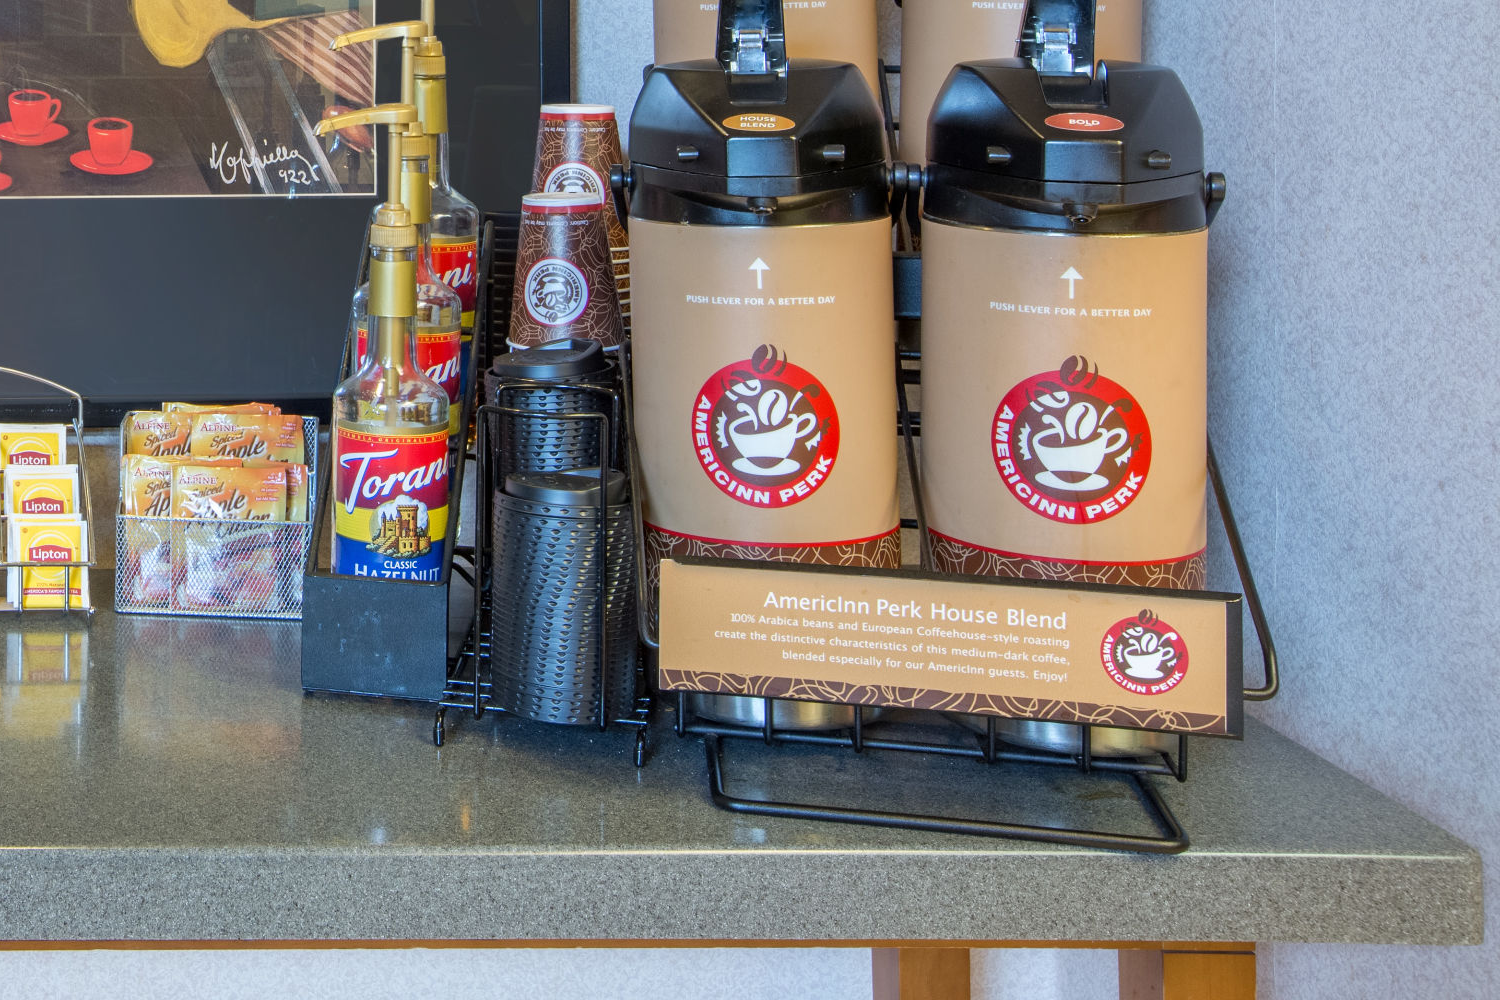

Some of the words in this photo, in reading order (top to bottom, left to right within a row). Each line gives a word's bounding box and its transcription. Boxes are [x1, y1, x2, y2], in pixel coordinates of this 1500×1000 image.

[972, 1, 994, 9] PUSH
[533, 266, 550, 283] PERK
[686, 294, 708, 303] PUSH
[712, 296, 741, 305] LEVER
[745, 297, 764, 305] FOR
[778, 297, 815, 306] BETTER
[817, 296, 836, 304] DAY
[989, 301, 1015, 312] PUSH
[1018, 304, 1050, 314] LEVER
[1054, 307, 1076, 316] FOR
[1080, 308, 1087, 317] A
[1091, 308, 1130, 317] BETTER
[1133, 308, 1152, 317] DAY
[133, 419, 170, 431] ALPINE
[200, 421, 237, 432] ALPINE
[144, 427, 177, 448] Spiced
[695, 394, 770, 504] AMERICINN
[779, 454, 833, 503] PERK
[12, 455, 47, 466] Lipton
[995, 404, 1076, 520] AMERICINN
[1085, 471, 1143, 519] PERK
[179, 473, 217, 484] ALPINE
[144, 481, 170, 496] Spice
[25, 502, 61, 513] Lipton
[32, 548, 69, 561] Lipton
[383, 560, 418, 570] CLASSIC
[876, 598, 923, 620] Perk
[930, 602, 998, 625] House
[1007, 608, 1067, 630] Blend
[730, 613, 756, 624] 100%
[758, 616, 799, 627] Arabica
[802, 618, 834, 630] beans
[838, 620, 858, 631] and
[862, 622, 913, 635] European
[1023, 636, 1070, 649] roasting
[714, 630, 746, 640] create
[750, 631, 767, 641] the
[770, 632, 826, 645] distinctive
[829, 637, 908, 652] characteristics
[911, 643, 923, 653] of
[926, 644, 947, 655] this
[1031, 653, 1071, 666] coffee,
[782, 650, 825, 662] blended
[829, 654, 882, 668] especially
[886, 657, 901, 668] for
[905, 661, 924, 670] our
[988, 667, 1029, 680] guests.
[1033, 670, 1068, 683] Enjoy!
[1102, 634, 1147, 693] AMERICINN
[1150, 670, 1184, 693] PERK
